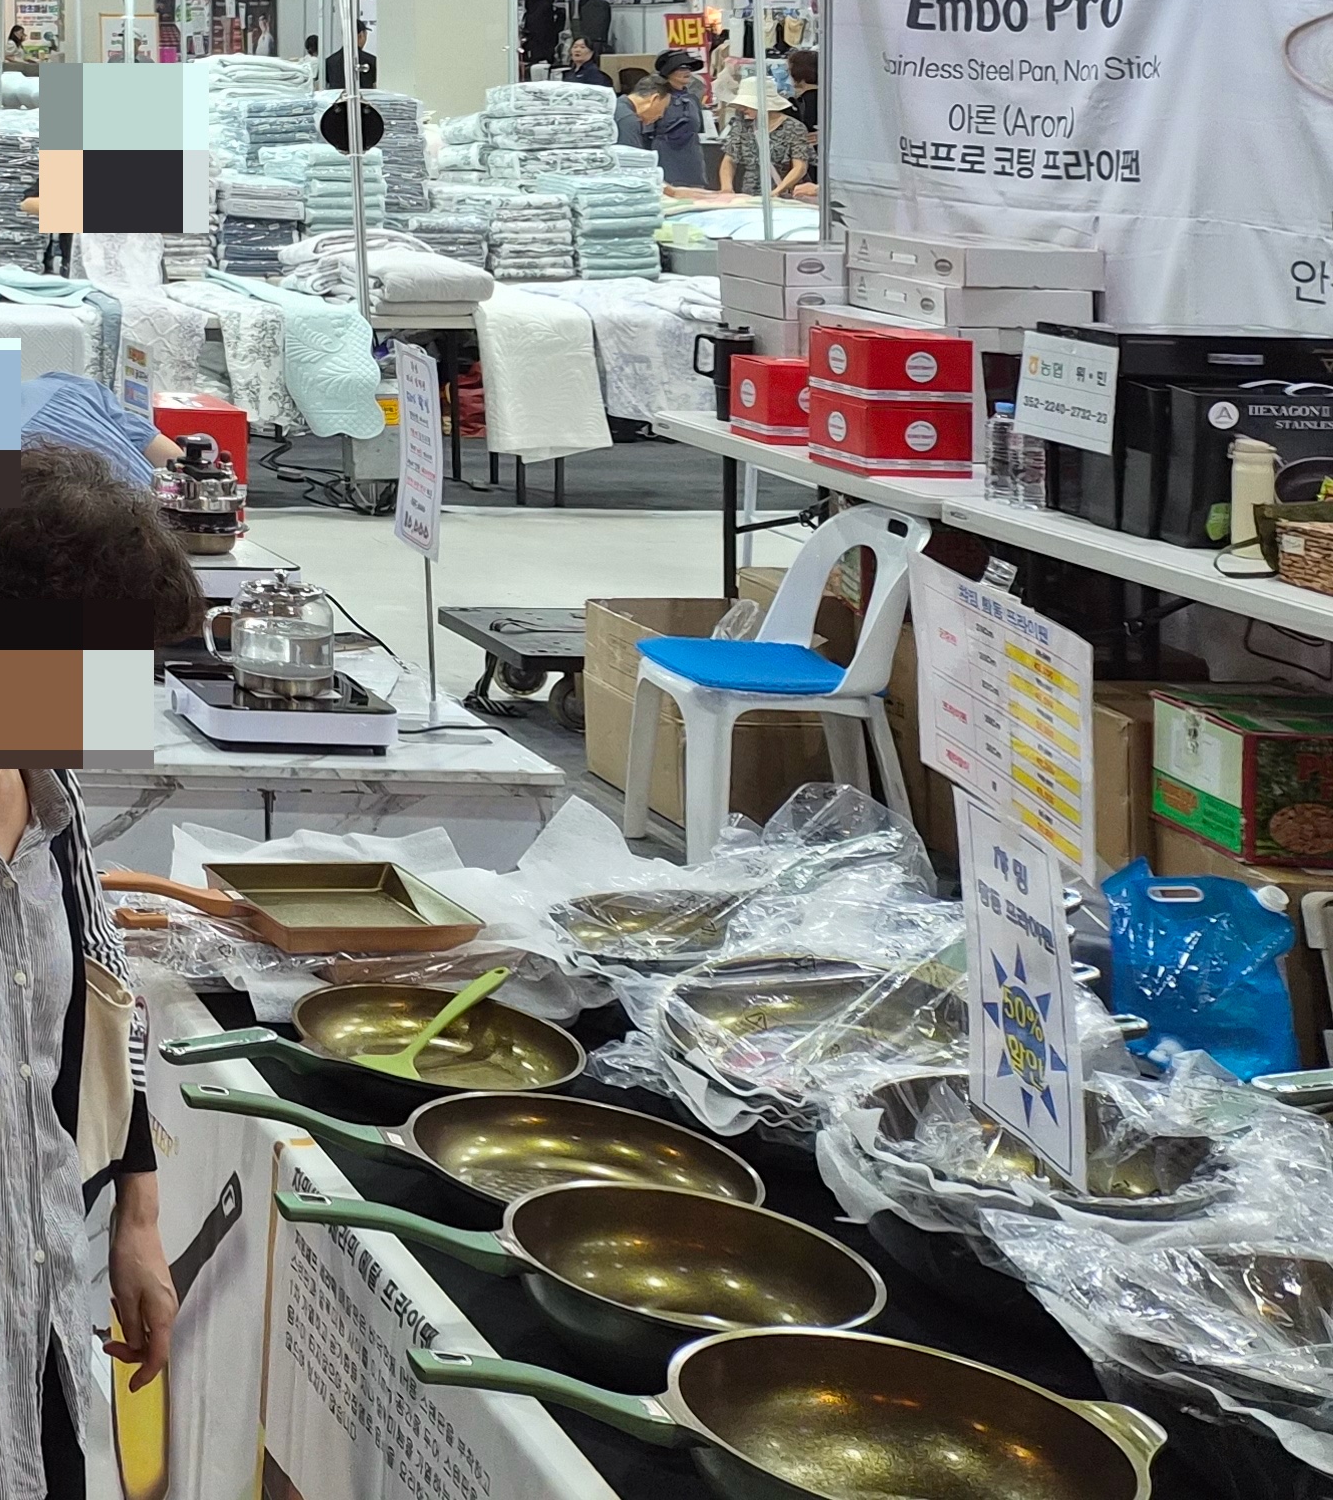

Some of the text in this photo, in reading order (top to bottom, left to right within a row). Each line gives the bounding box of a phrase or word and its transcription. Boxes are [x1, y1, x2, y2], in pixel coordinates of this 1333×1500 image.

[667, 20, 705, 45] 시타
[967, 58, 1014, 82] Steel
[1018, 60, 1059, 85] Pan,
[1104, 55, 1161, 80] Stick
[948, 103, 1075, 139] 아론 (Aron)
[993, 146, 1036, 179] 코팅
[1041, 149, 1141, 183] 프라이팬
[1003, 984, 1044, 1043] 50%
